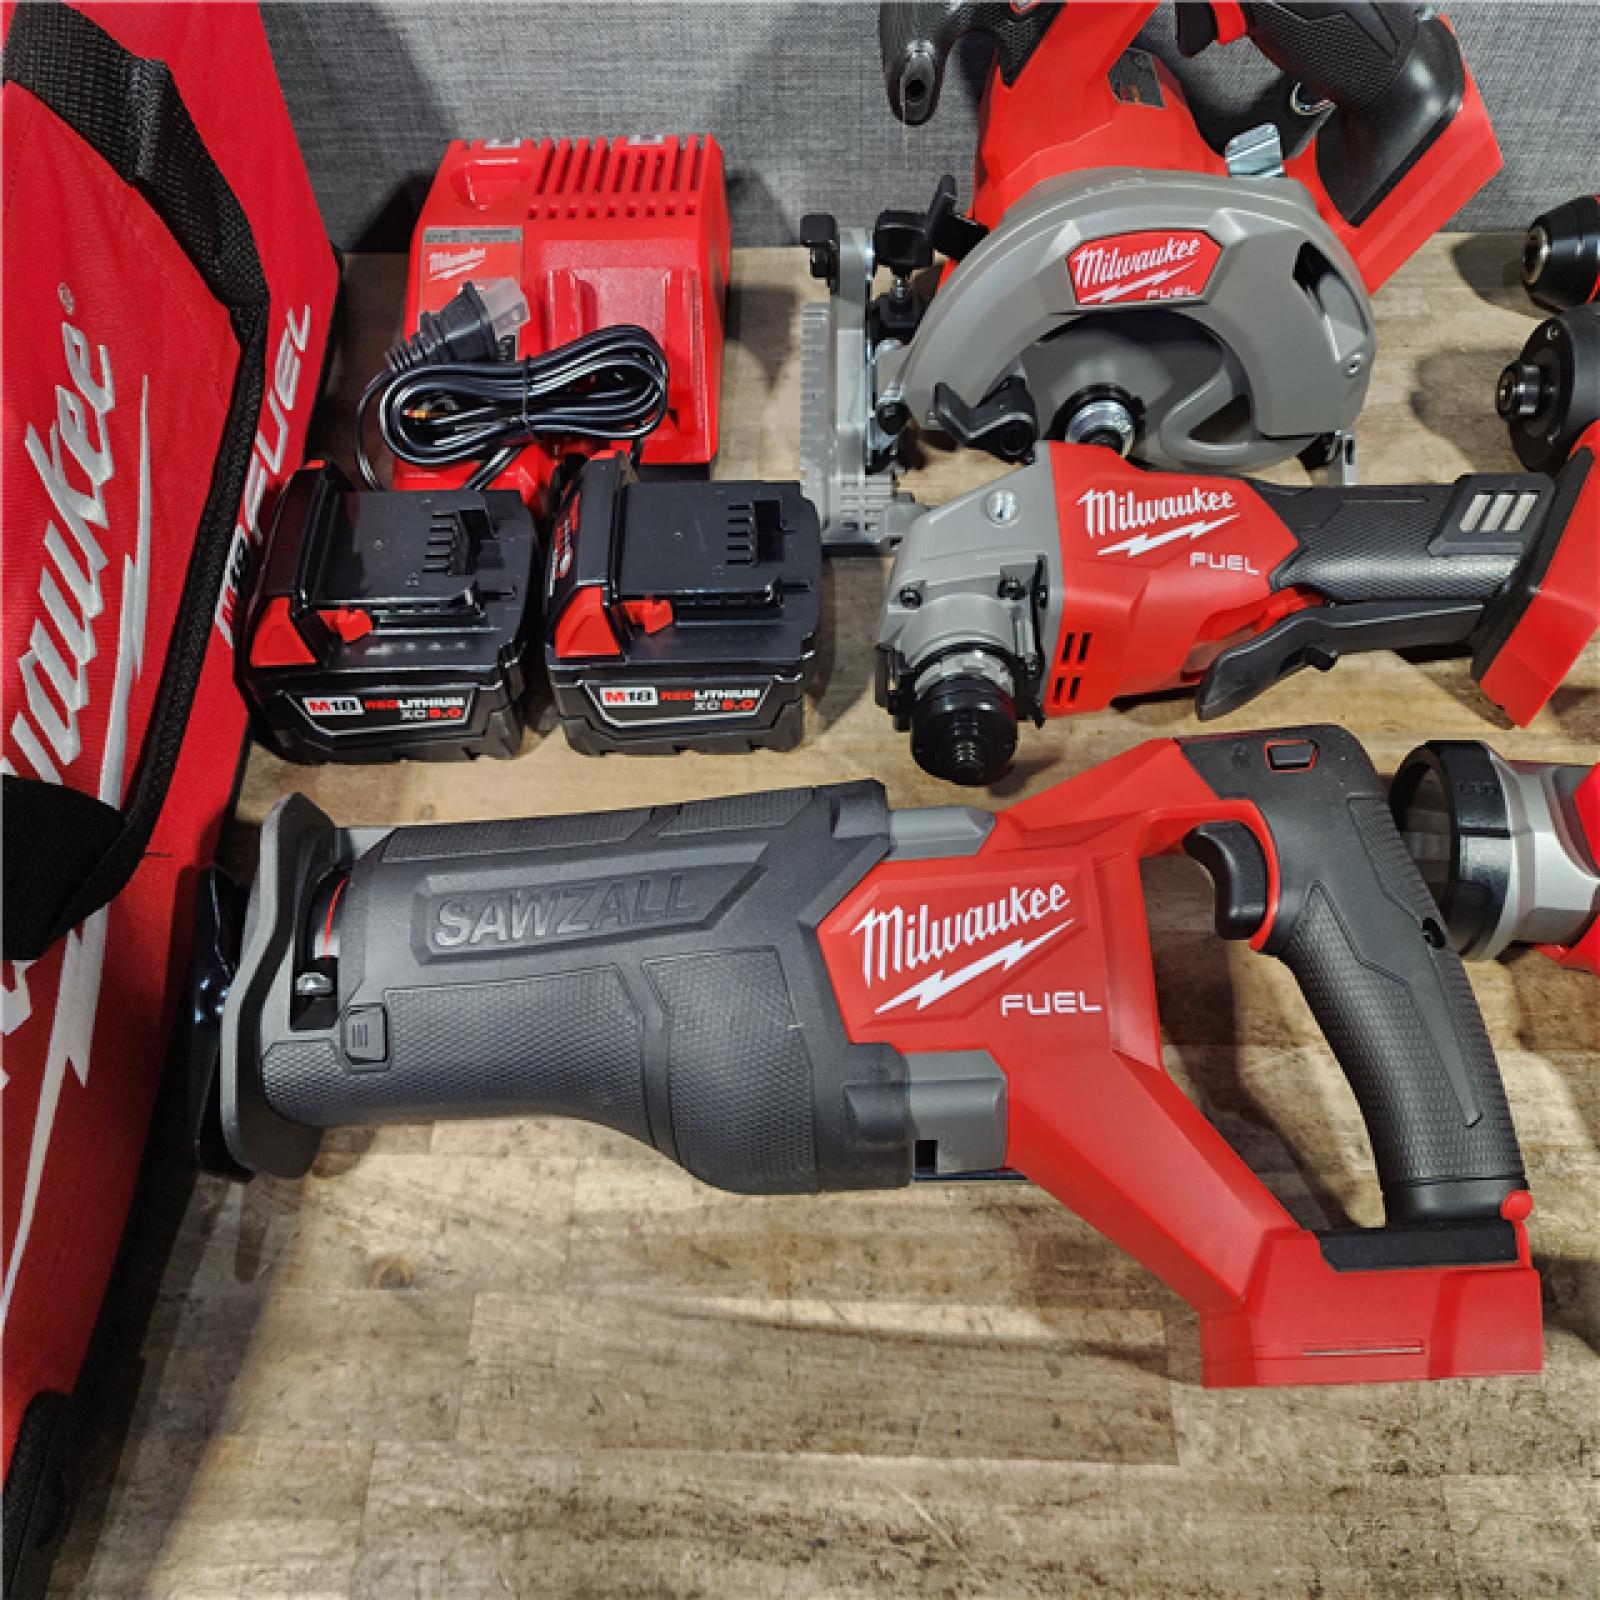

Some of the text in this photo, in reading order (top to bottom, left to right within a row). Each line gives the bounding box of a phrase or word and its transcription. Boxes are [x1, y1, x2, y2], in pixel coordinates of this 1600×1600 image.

[1074, 237, 1201, 288] Milwaukee
[1145, 284, 1197, 299] FUEL
[244, 303, 312, 546] FUEL
[1077, 486, 1236, 538] Milwaukee
[1189, 551, 1260, 576] FUEL
[307, 699, 361, 714] M18
[603, 689, 656, 704] M18
[433, 873, 697, 947] SAWZALL
[850, 882, 1070, 988] Milwaukee
[1001, 991, 1102, 1017] FUEL
